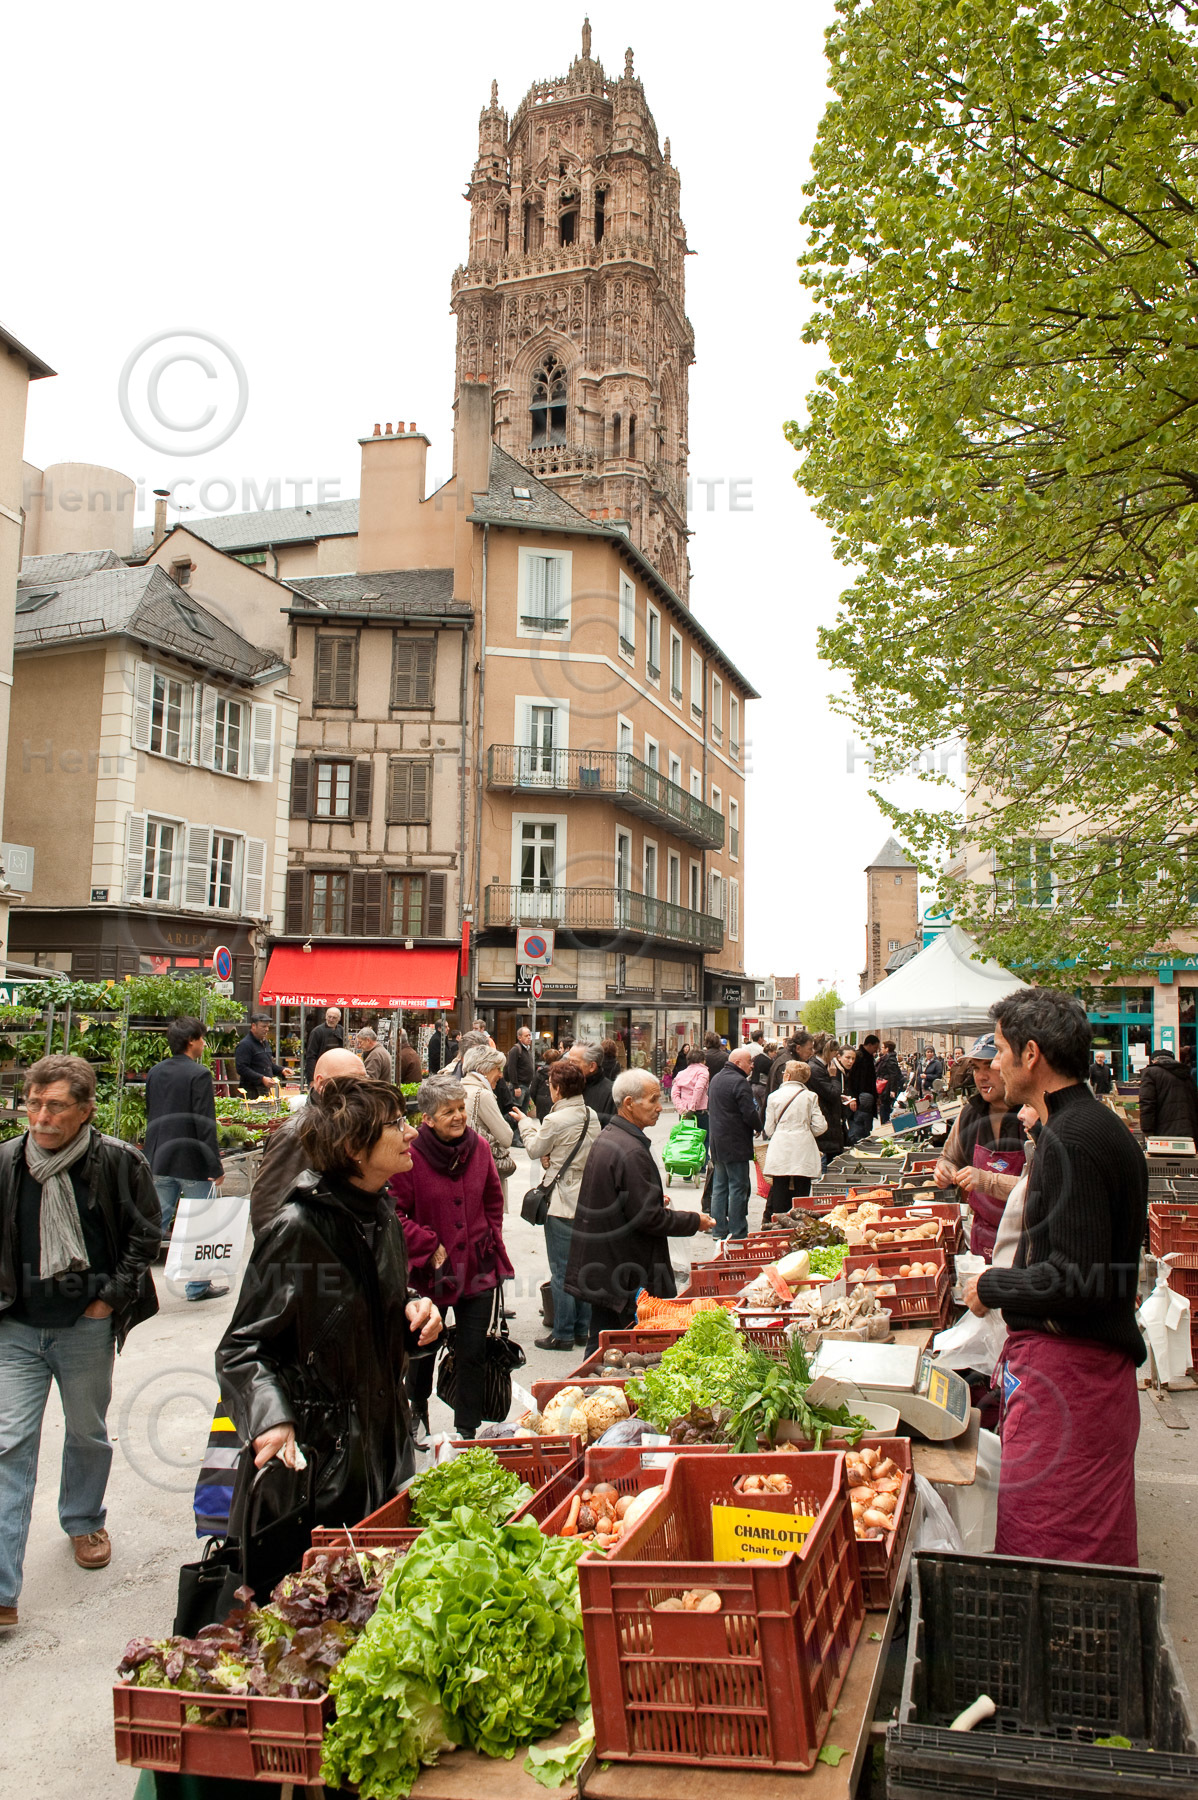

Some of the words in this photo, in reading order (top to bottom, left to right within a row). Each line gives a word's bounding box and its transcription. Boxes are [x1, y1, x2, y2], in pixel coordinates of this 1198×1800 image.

[167, 932, 215, 946] ARLENE
[275, 995, 299, 1005] Midi
[300, 996, 327, 1005] Libre
[194, 1243, 233, 1261] BRICE
[741, 1543, 770, 1555] Chair
